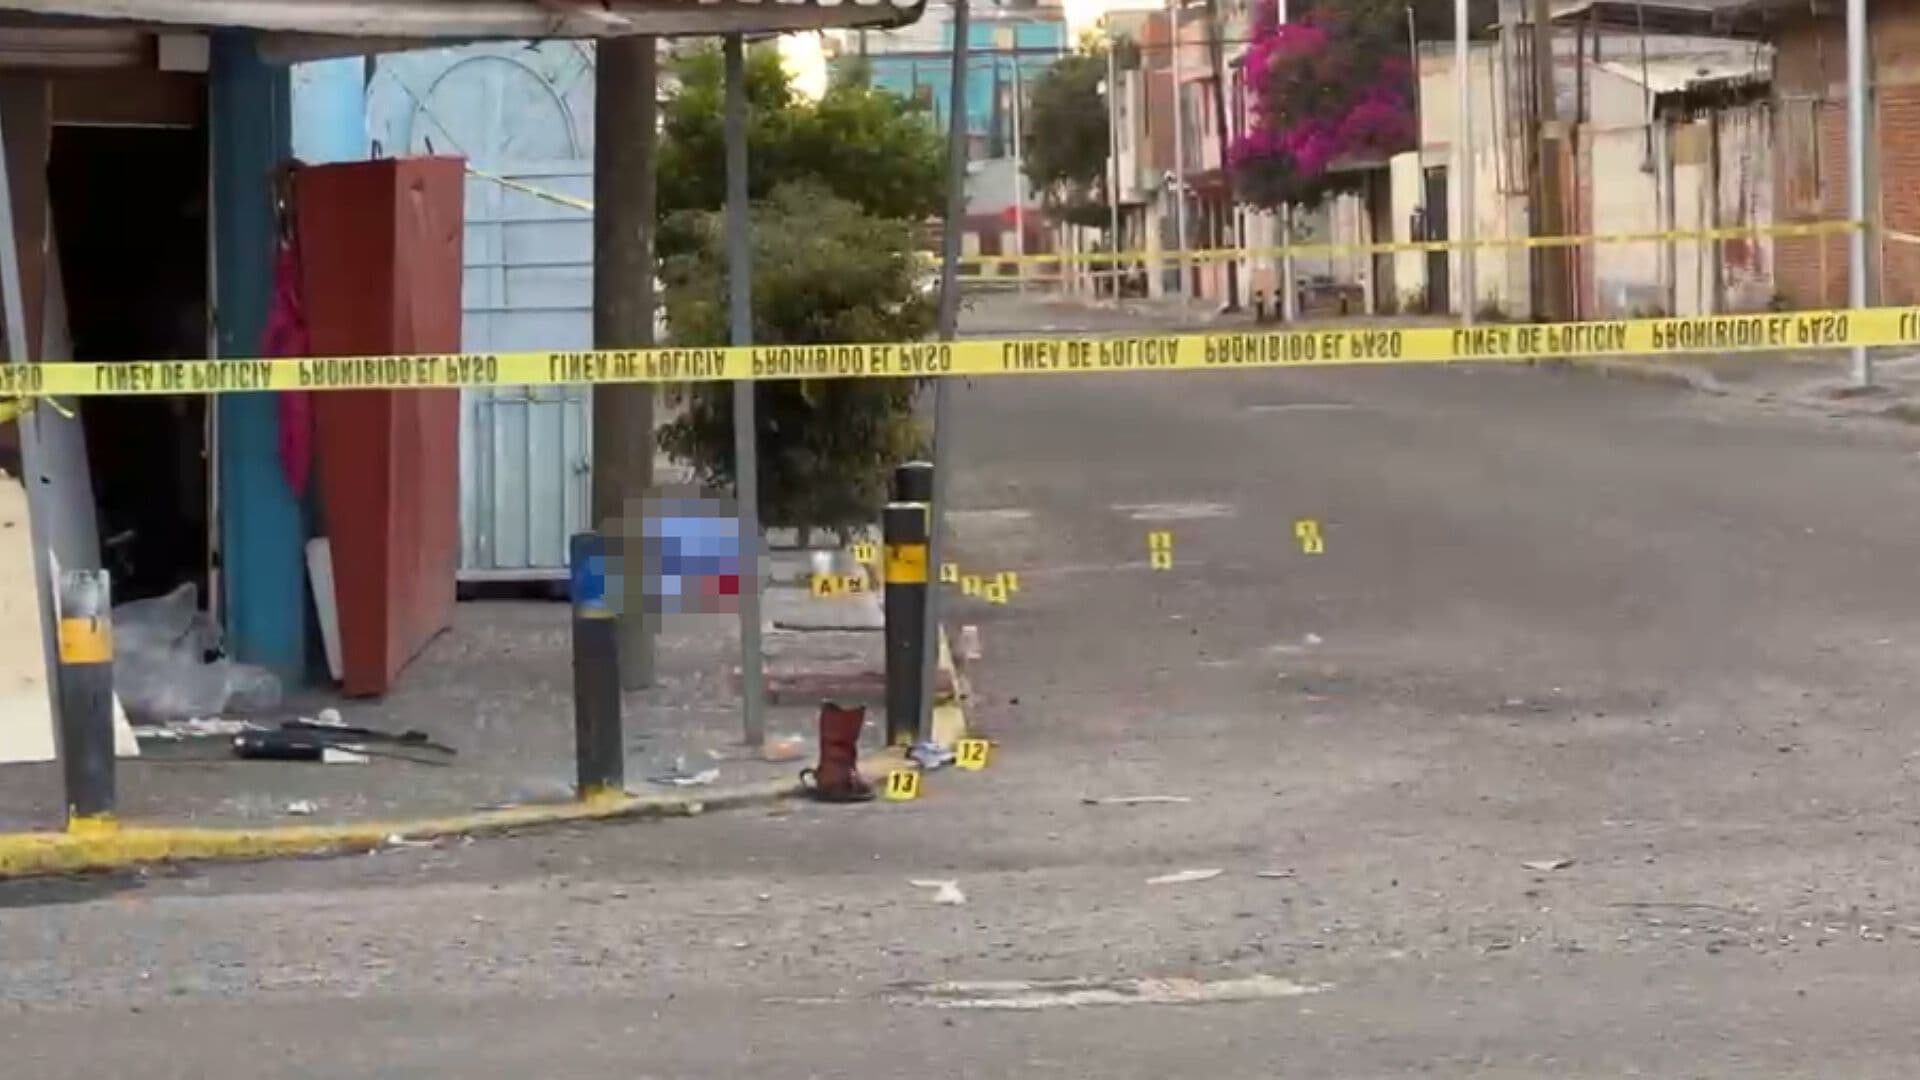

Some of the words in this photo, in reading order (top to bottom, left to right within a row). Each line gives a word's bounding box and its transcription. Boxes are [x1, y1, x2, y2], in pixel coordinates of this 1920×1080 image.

[819, 579, 833, 594] A
[963, 742, 985, 761] 12
[893, 773, 914, 793] 13
